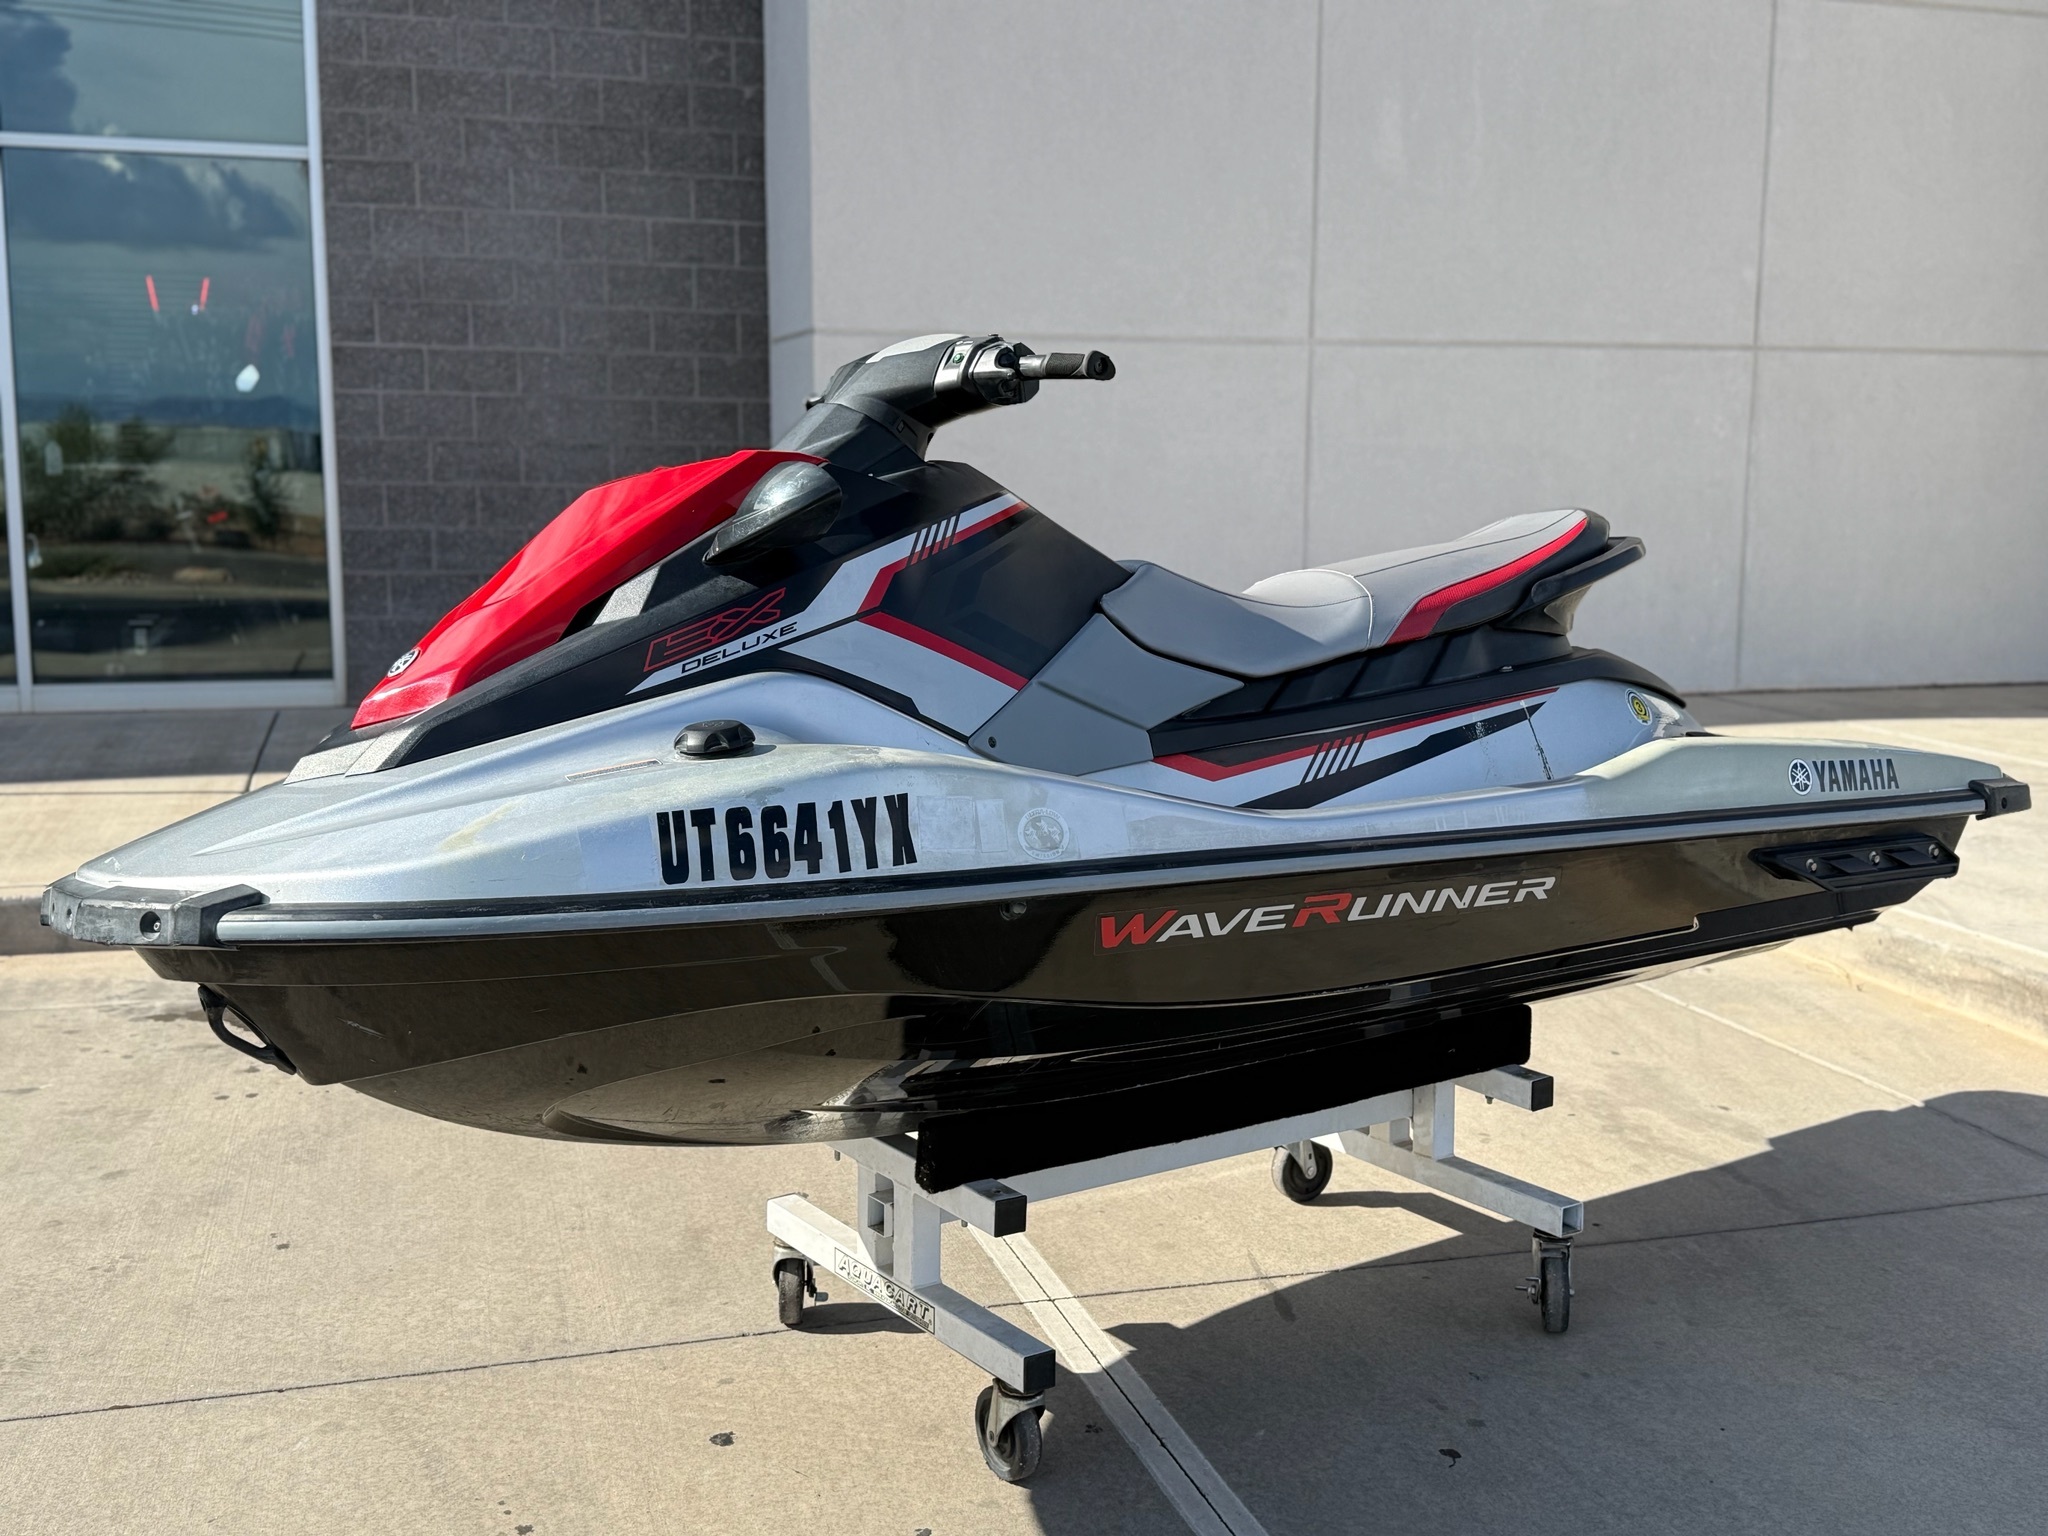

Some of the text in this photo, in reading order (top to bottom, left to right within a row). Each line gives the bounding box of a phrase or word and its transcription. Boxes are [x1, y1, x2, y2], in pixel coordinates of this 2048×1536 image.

[643, 587, 786, 672] EX
[680, 621, 798, 674] DELUXE
[1812, 758, 1900, 793] YAMAHA
[656, 792, 918, 885] UT6641YX
[1100, 876, 1556, 949] WAVERUNNER
[838, 1254, 930, 1320] AQUACART
